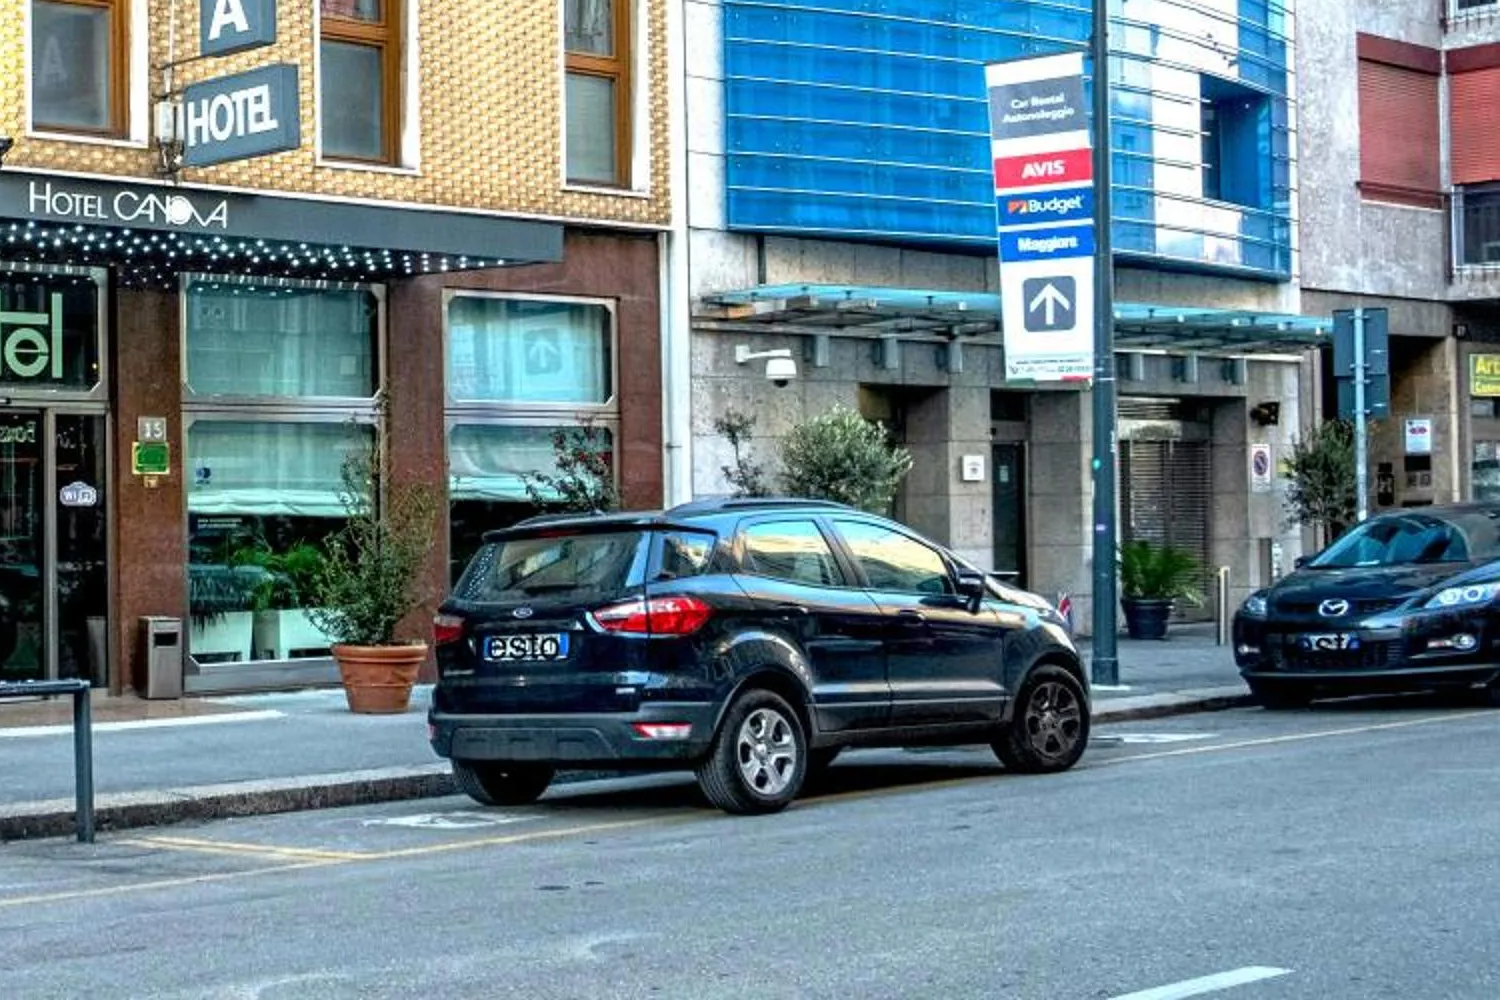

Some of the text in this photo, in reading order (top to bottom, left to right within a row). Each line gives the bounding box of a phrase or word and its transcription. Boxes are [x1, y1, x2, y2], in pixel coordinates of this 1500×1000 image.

[187, 83, 279, 147] HOTEL
[1021, 158, 1066, 180] AVIS
[1027, 195, 1083, 215] Budget
[144, 422, 164, 439] 15
